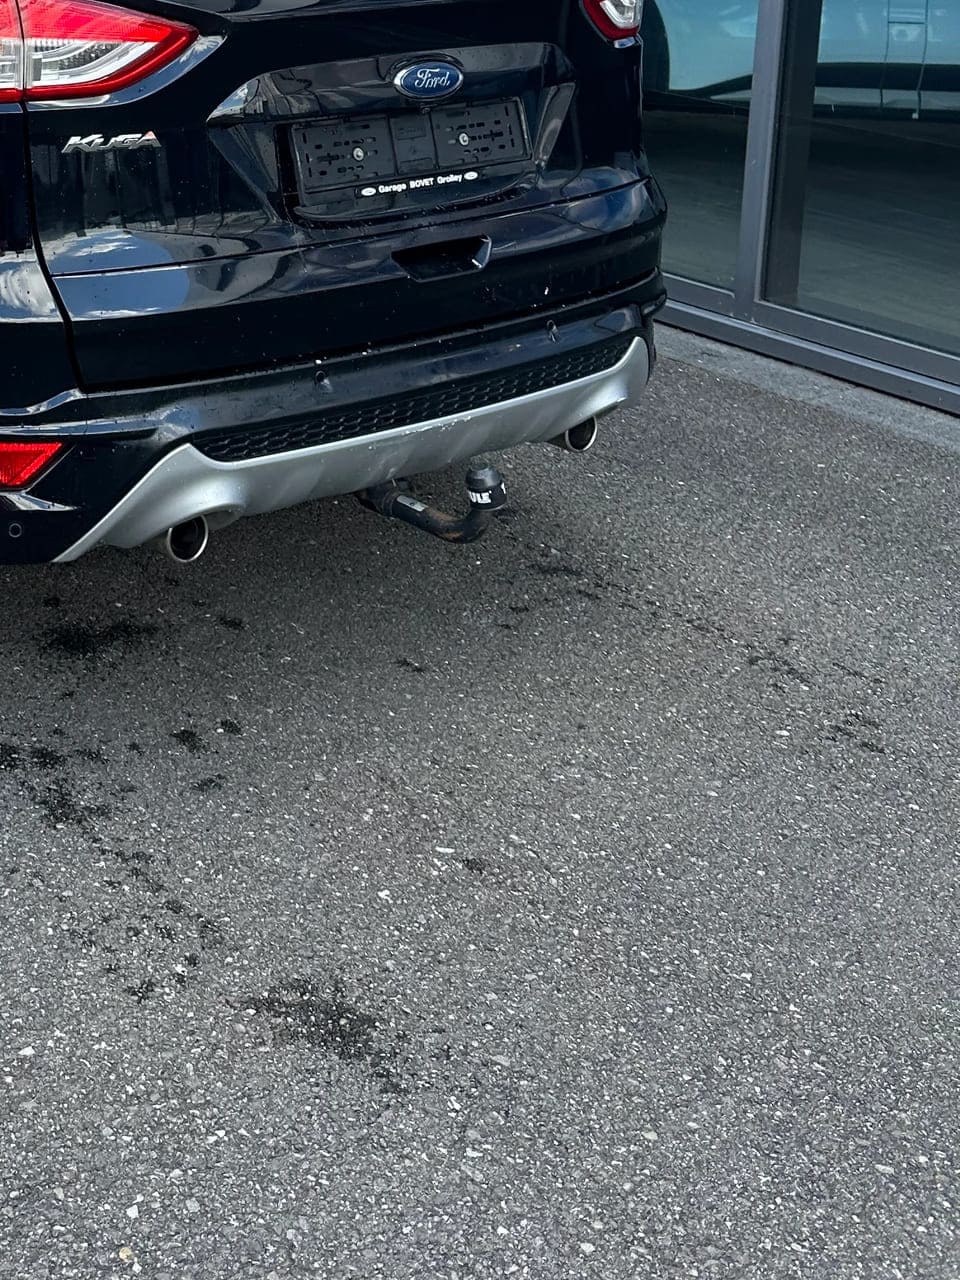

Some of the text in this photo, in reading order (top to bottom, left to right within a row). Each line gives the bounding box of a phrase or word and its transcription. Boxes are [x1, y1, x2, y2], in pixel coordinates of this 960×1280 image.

[414, 68, 450, 88] Ford
[61, 131, 162, 154] KUGA
[378, 183, 407, 194] Garage
[409, 178, 435, 189] BOVET
